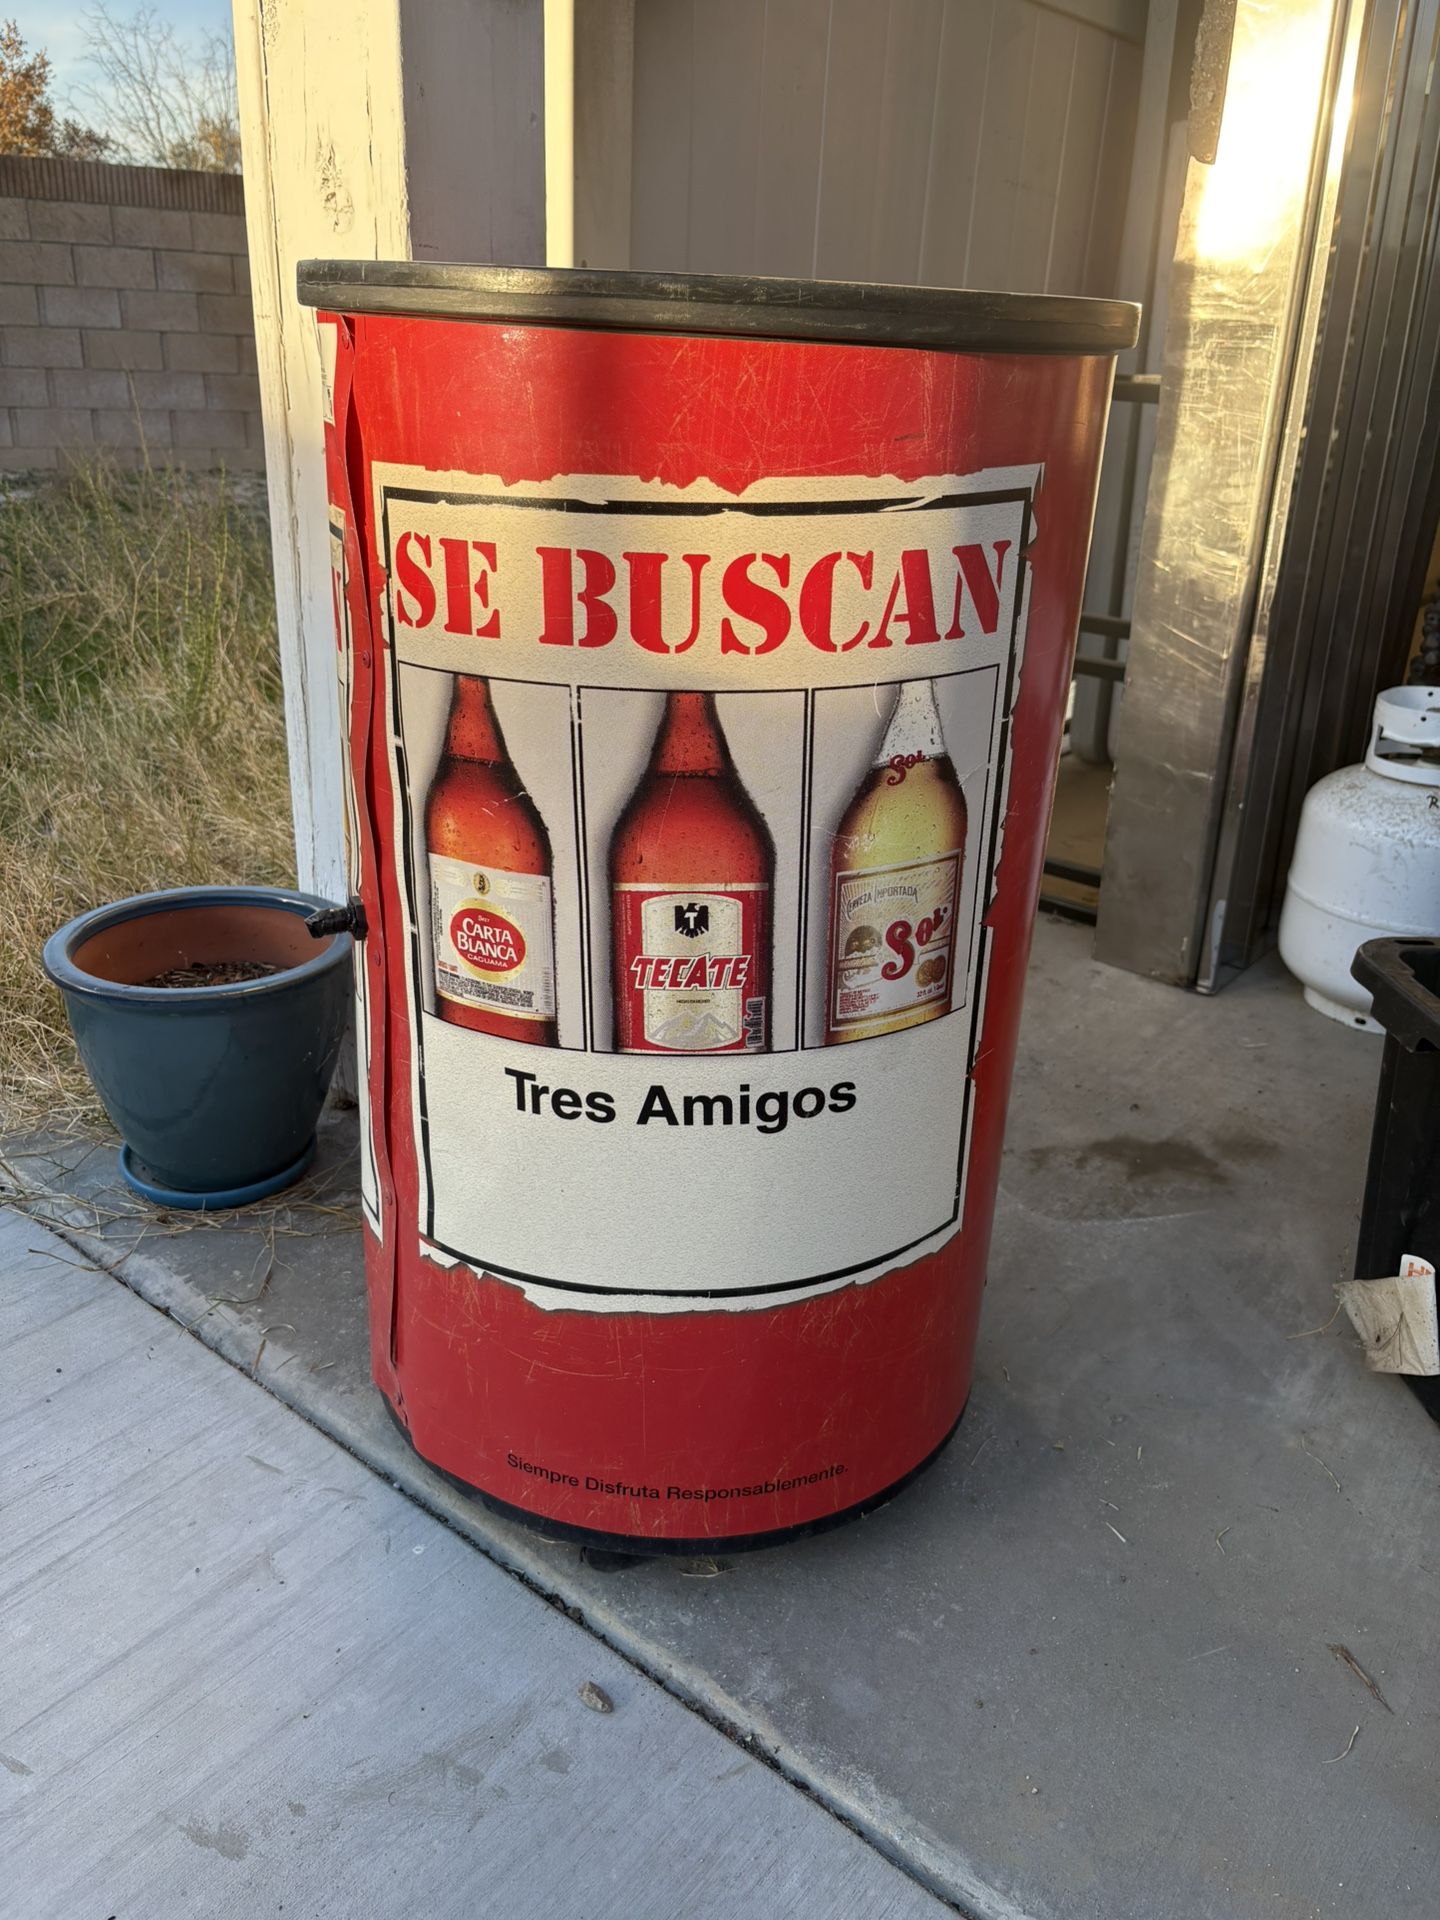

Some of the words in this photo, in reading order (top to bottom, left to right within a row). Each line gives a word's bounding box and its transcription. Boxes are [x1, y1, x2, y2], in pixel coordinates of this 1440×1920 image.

[395, 531, 501, 639] SE
[536, 540, 1012, 655] BUSCAN
[887, 750, 926, 786] Sol
[456, 930, 518, 962] BLANCA
[462, 917, 514, 945] CARTA
[881, 906, 948, 980] Sol
[467, 953, 508, 968] CAGUAMA
[630, 952, 752, 991] TECATE
[504, 1067, 616, 1123] Tres
[636, 1081, 857, 1134] Amigos
[507, 1453, 579, 1487] Siempre
[585, 1477, 660, 1500] Disfruta
[666, 1464, 850, 1503] Responsablemente.
